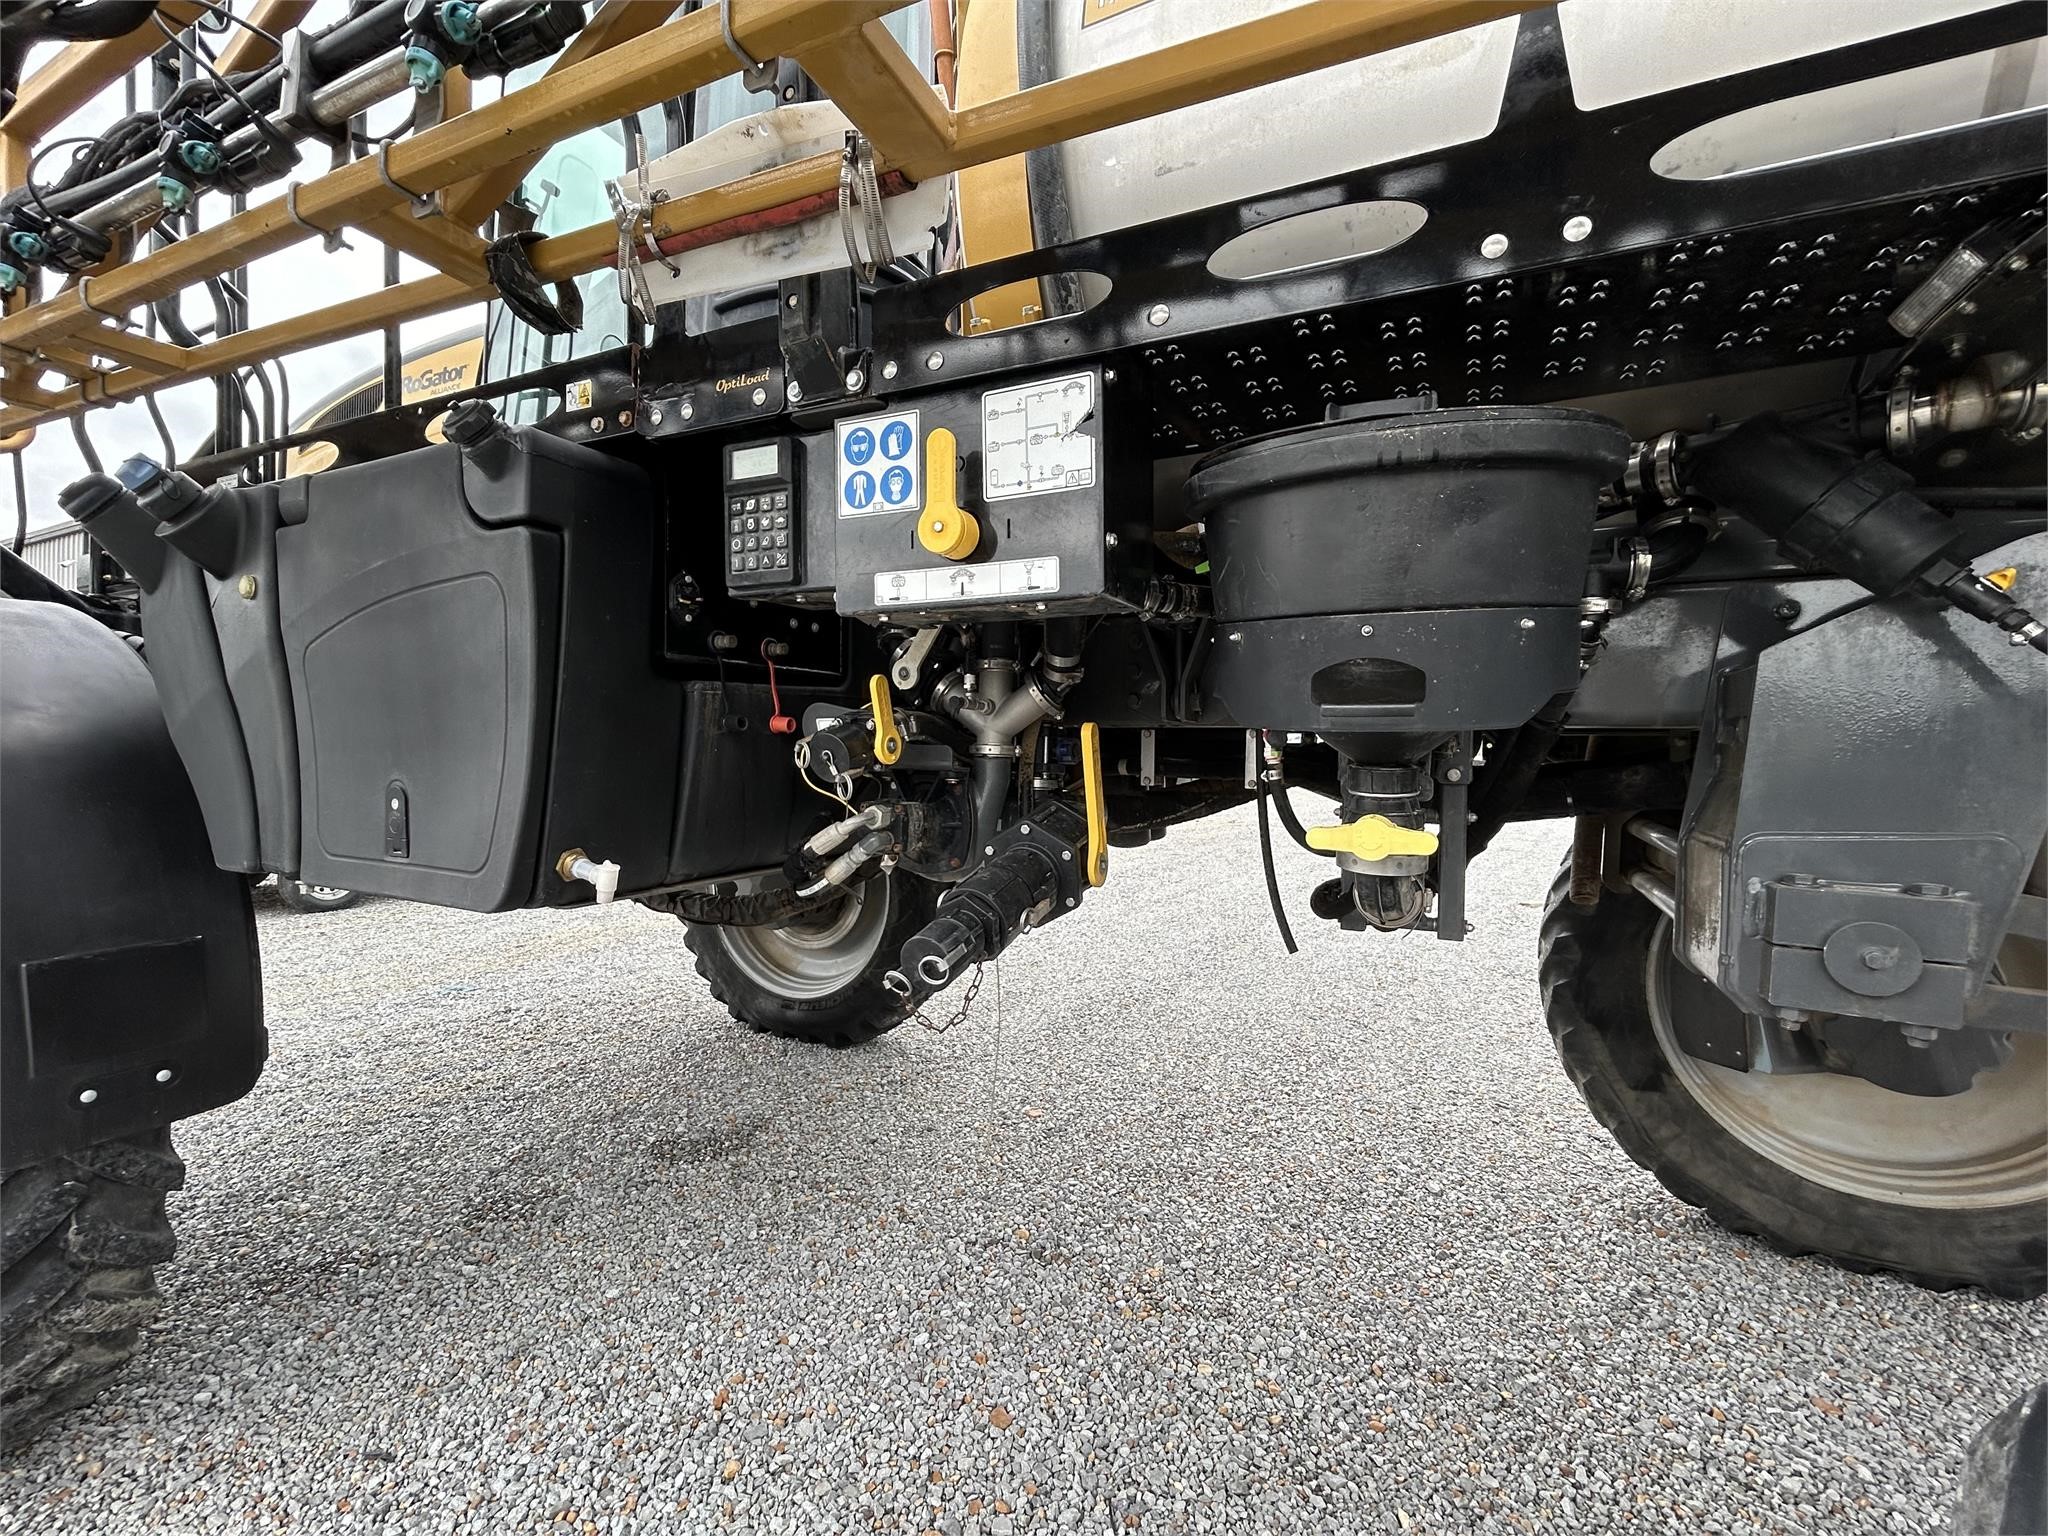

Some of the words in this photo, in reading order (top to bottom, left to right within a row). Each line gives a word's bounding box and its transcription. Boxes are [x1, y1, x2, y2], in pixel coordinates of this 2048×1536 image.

[402, 364, 468, 394] RoGator
[715, 367, 770, 394] OptiLoad
[762, 555, 770, 565] A
